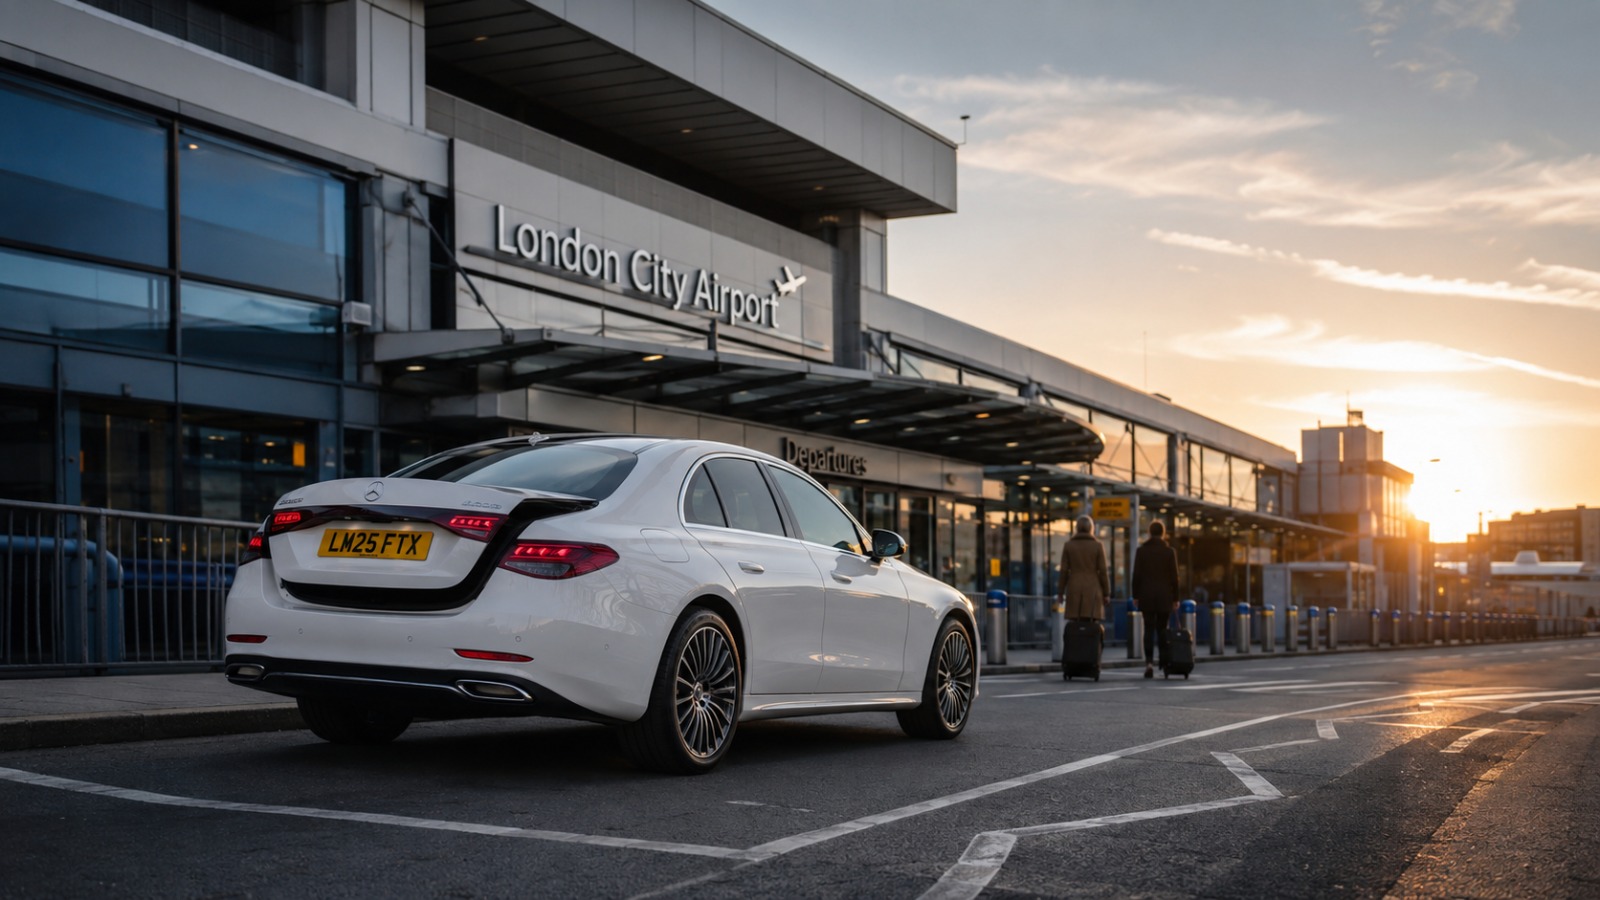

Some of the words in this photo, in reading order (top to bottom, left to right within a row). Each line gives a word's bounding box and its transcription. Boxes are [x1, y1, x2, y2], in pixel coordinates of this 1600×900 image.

[496, 204, 620, 284] London
[630, 249, 688, 310] City
[693, 269, 780, 329] Airport
[783, 438, 867, 475] Departures
[328, 532, 380, 553] LM25
[380, 533, 423, 555] FTX
